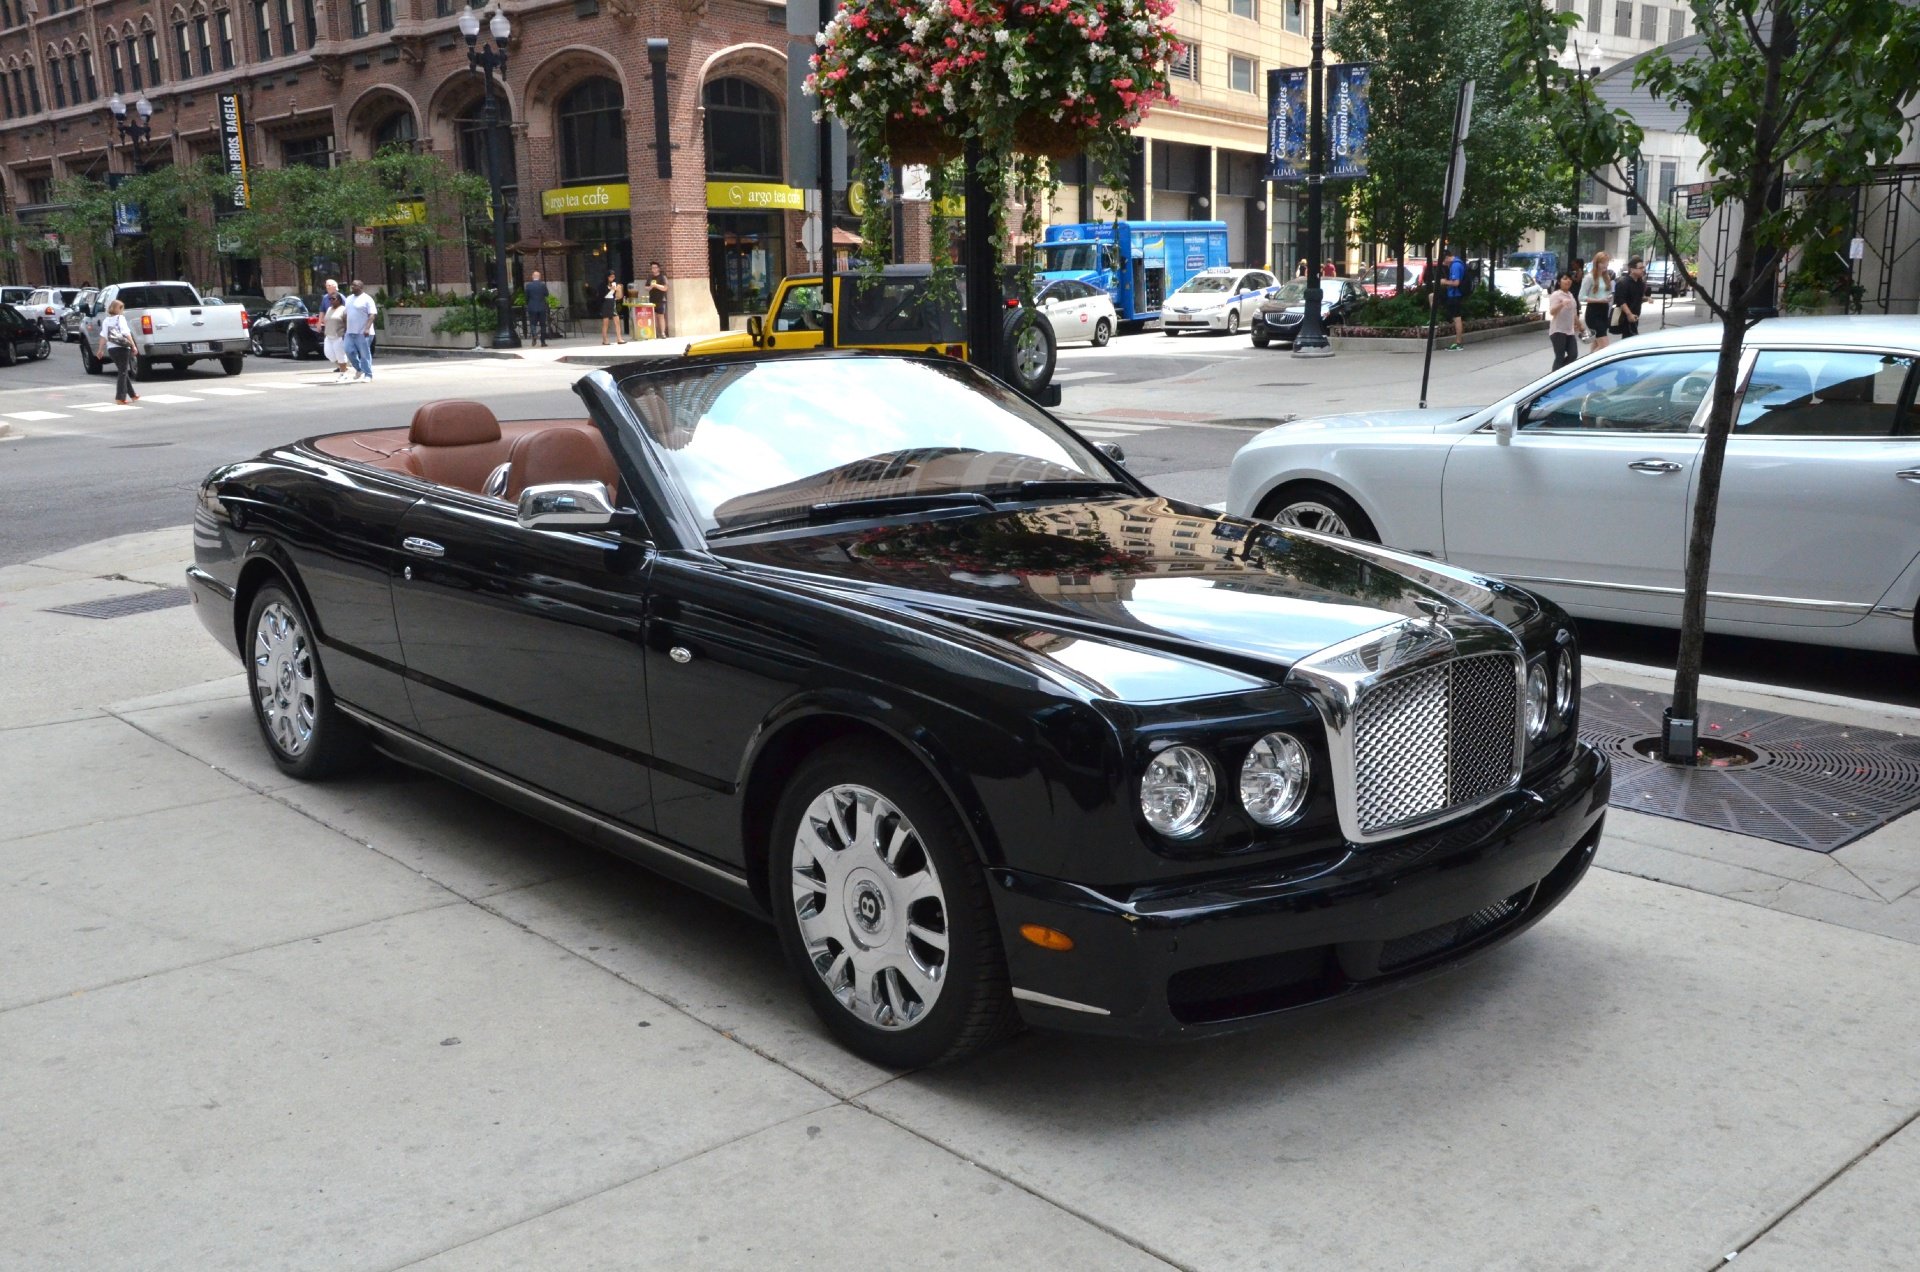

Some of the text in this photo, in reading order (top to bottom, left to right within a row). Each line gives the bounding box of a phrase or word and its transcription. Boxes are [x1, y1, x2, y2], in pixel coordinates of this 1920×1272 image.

[223, 96, 238, 133] BAGELS
[1275, 86, 1290, 159] Cosmologies
[1336, 81, 1352, 156] Cosmologies
[1272, 169, 1297, 177] LUMA
[1334, 165, 1358, 173] LUMA
[566, 194, 579, 207] tea
[582, 186, 609, 205] café
[748, 191, 772, 207] argo
[773, 190, 786, 204] tea
[861, 897, 875, 919] B
